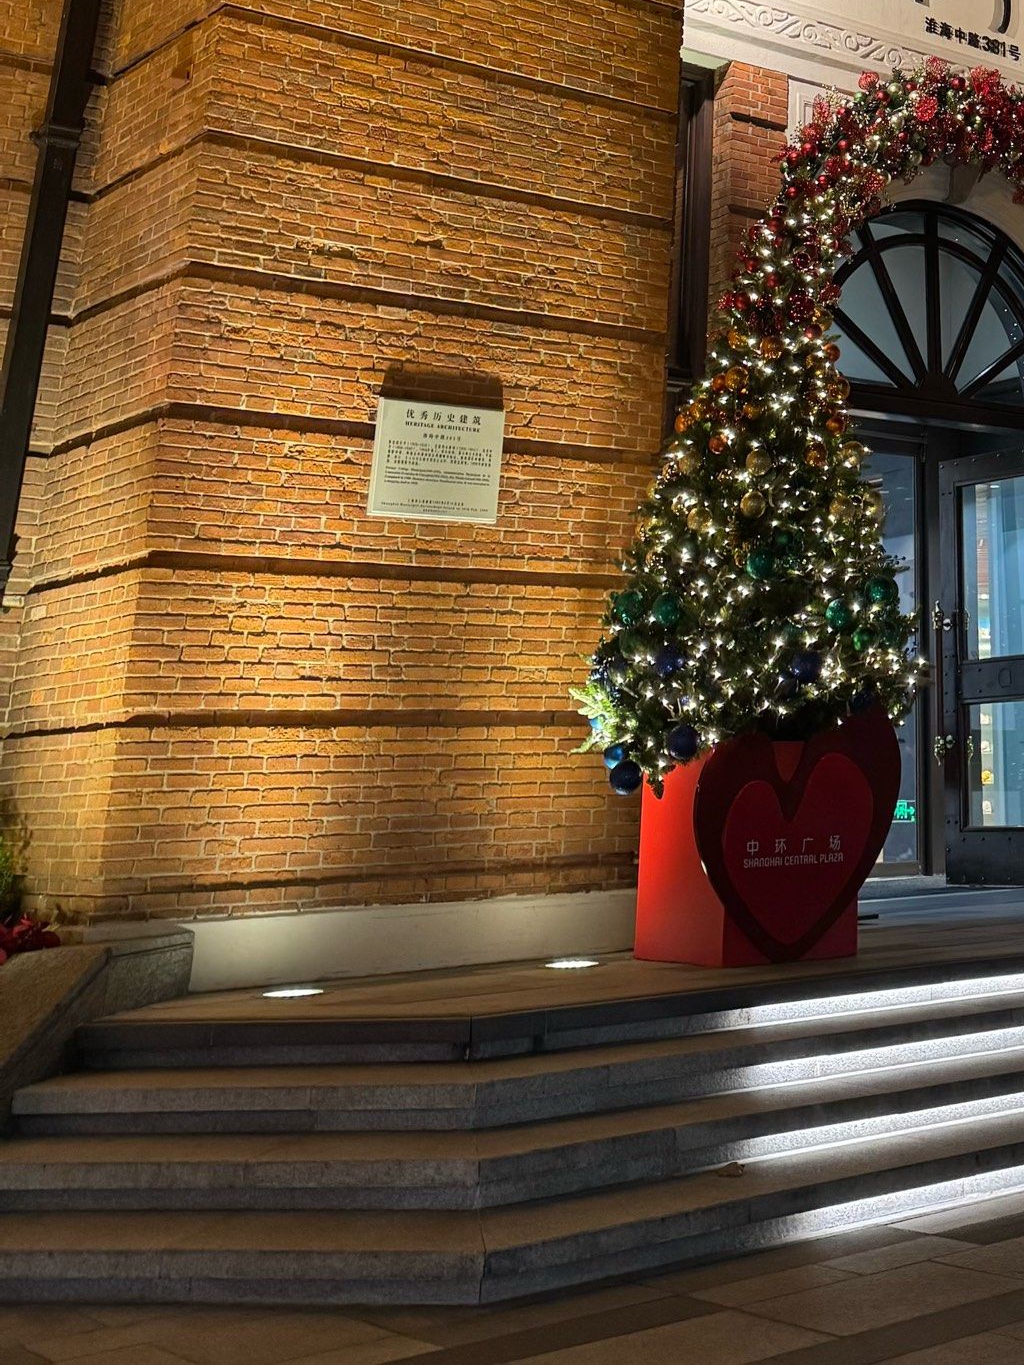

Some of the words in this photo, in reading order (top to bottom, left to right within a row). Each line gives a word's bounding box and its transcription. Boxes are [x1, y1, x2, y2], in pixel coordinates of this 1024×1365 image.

[925, 16, 1021, 61] 淮海中路381号
[406, 408, 481, 426] 优秀历史建筑
[405, 420, 434, 429] HERITAGE
[437, 424, 480, 433] ARCHITECTURE
[746, 835, 841, 856] 中环广场
[743, 856, 783, 869] SHANGHAI
[784, 854, 818, 866] CENTRAL
[819, 852, 844, 864] PLAZA
